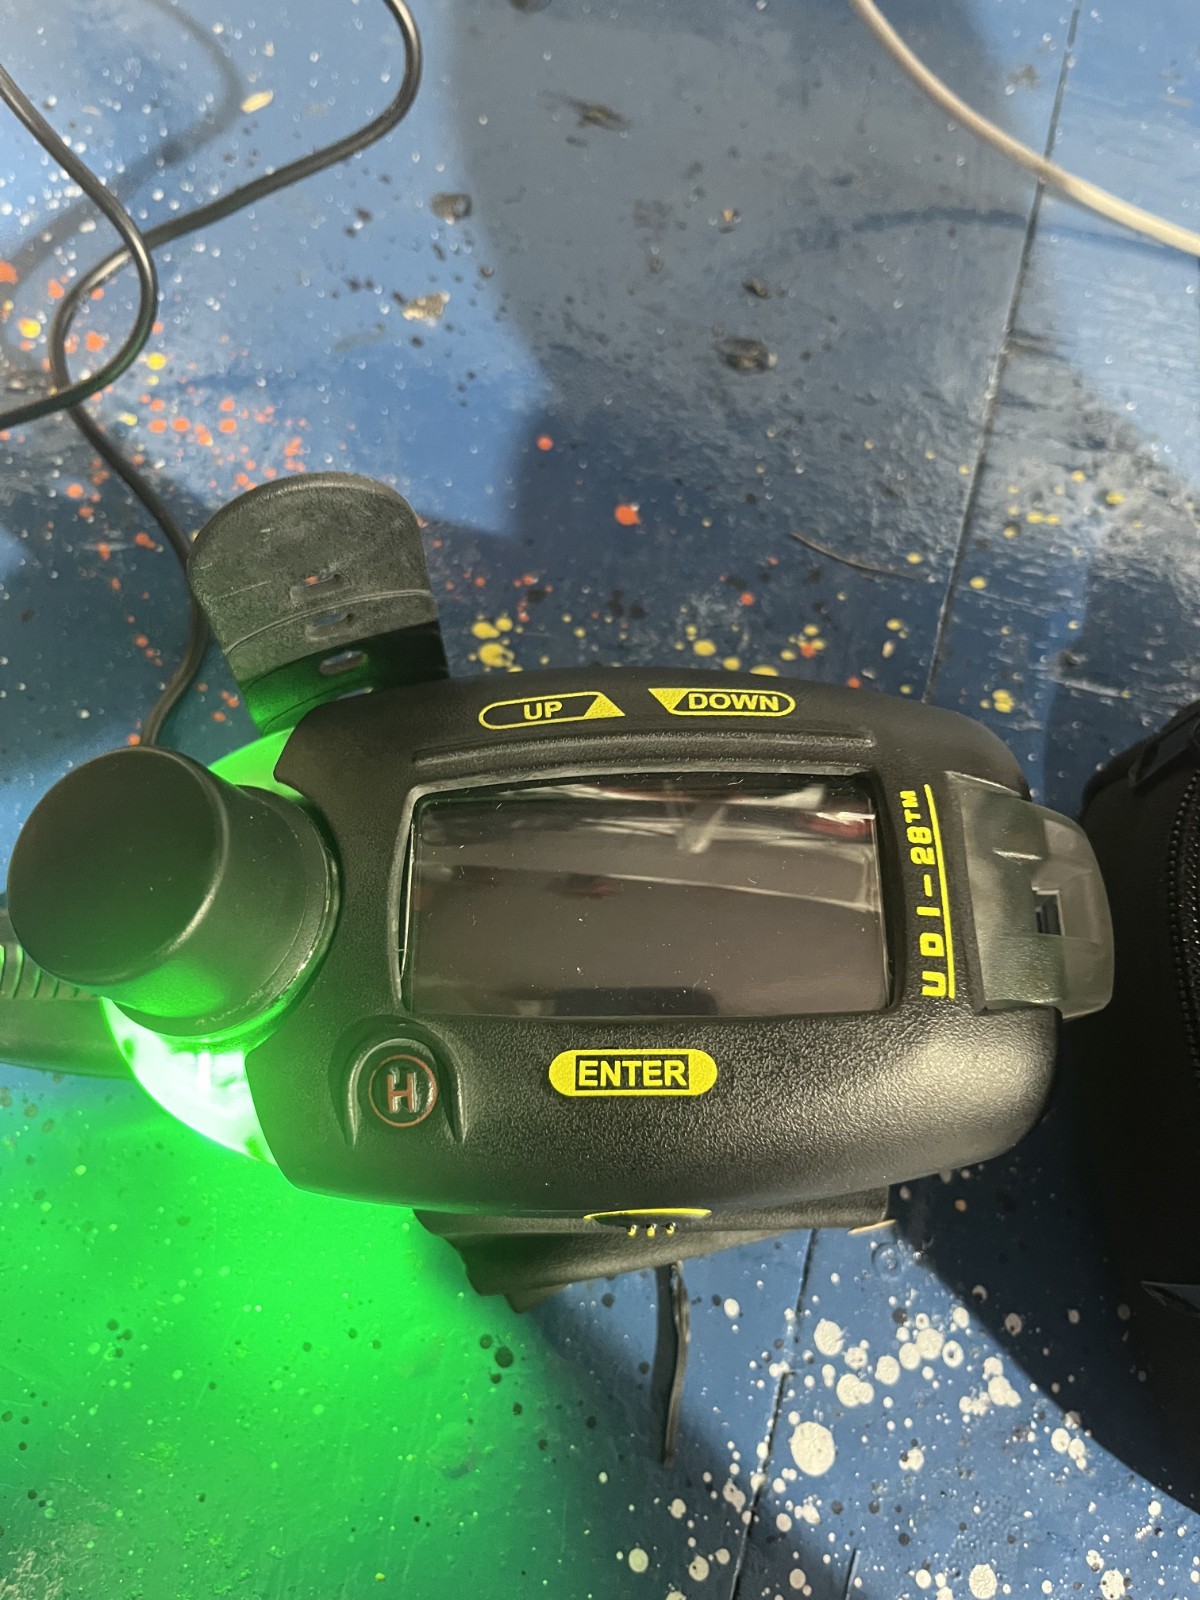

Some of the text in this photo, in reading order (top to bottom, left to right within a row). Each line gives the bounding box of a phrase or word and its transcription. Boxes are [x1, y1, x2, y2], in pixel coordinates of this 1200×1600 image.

[524, 700, 563, 720] UP
[688, 693, 779, 711] DOWN
[578, 1059, 687, 1087] ENTER
[386, 1070, 417, 1114] H
